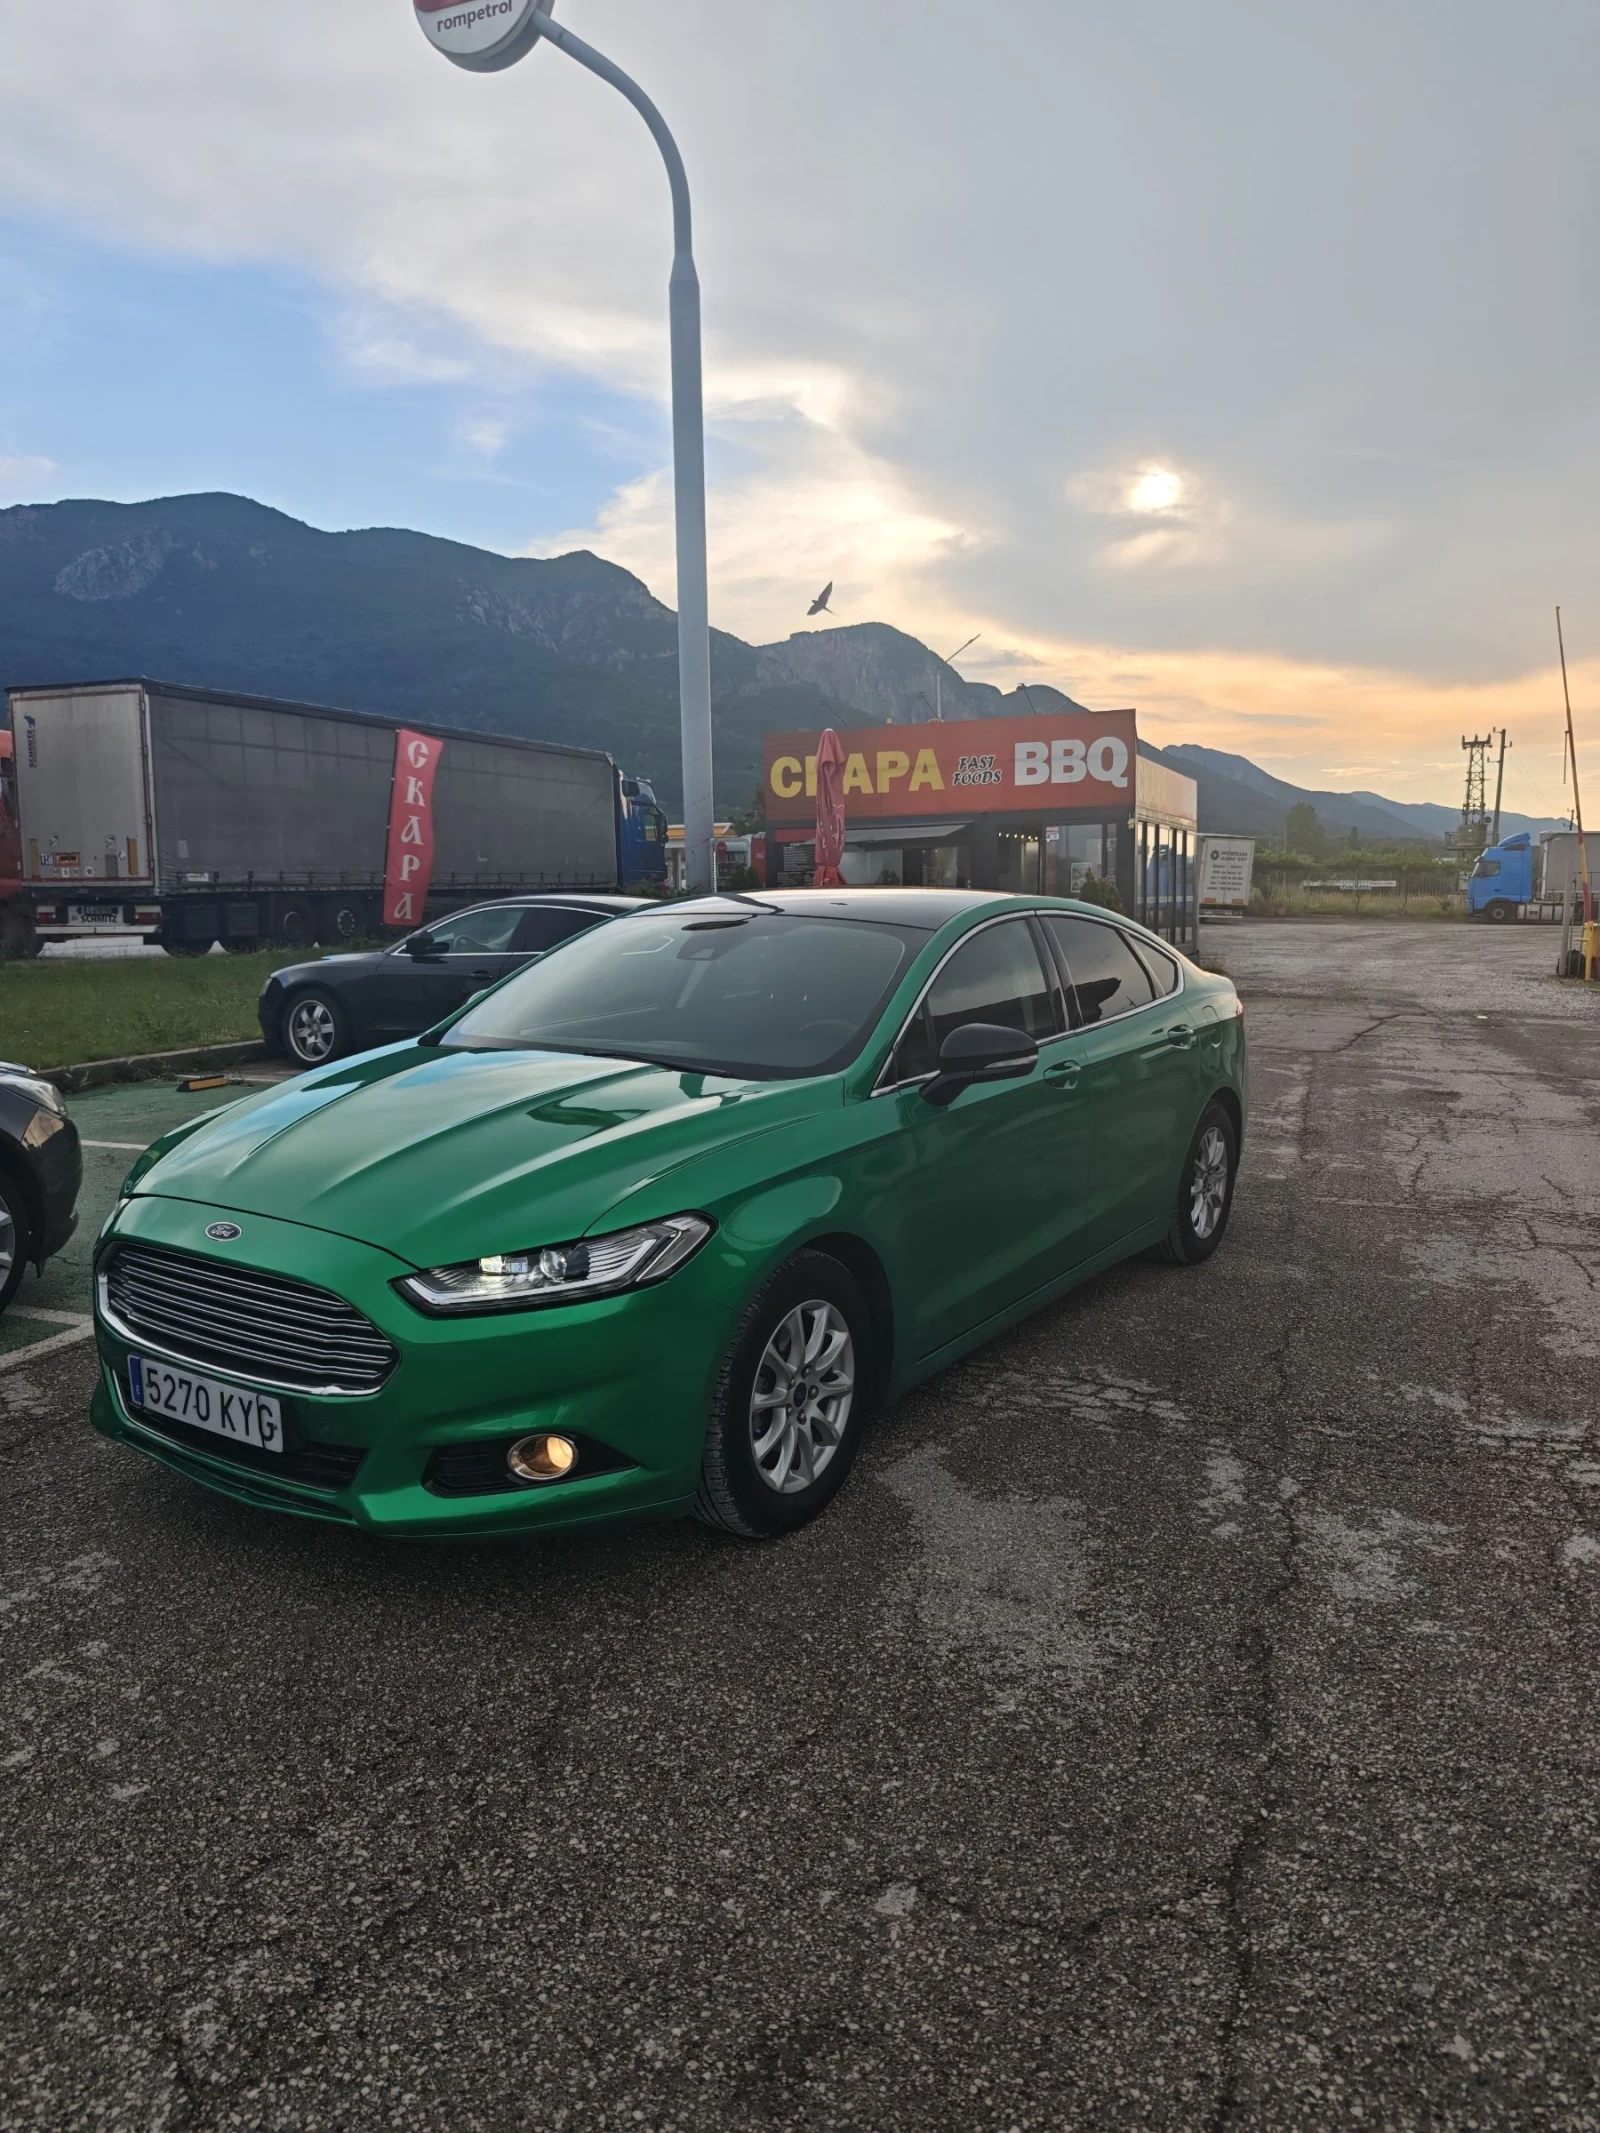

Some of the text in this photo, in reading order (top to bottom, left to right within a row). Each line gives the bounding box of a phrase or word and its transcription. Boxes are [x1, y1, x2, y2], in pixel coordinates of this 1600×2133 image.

[436, 0, 513, 32] rompetrol
[958, 754, 996, 771] FAST
[1014, 736, 1128, 788] BBQ
[952, 769, 1002, 786] FOODS
[394, 740, 429, 920] СКАРА
[80, 913, 118, 923] SCHMITZ
[211, 1225, 235, 1238] Ford
[147, 1369, 276, 1442] 5270 KYG
